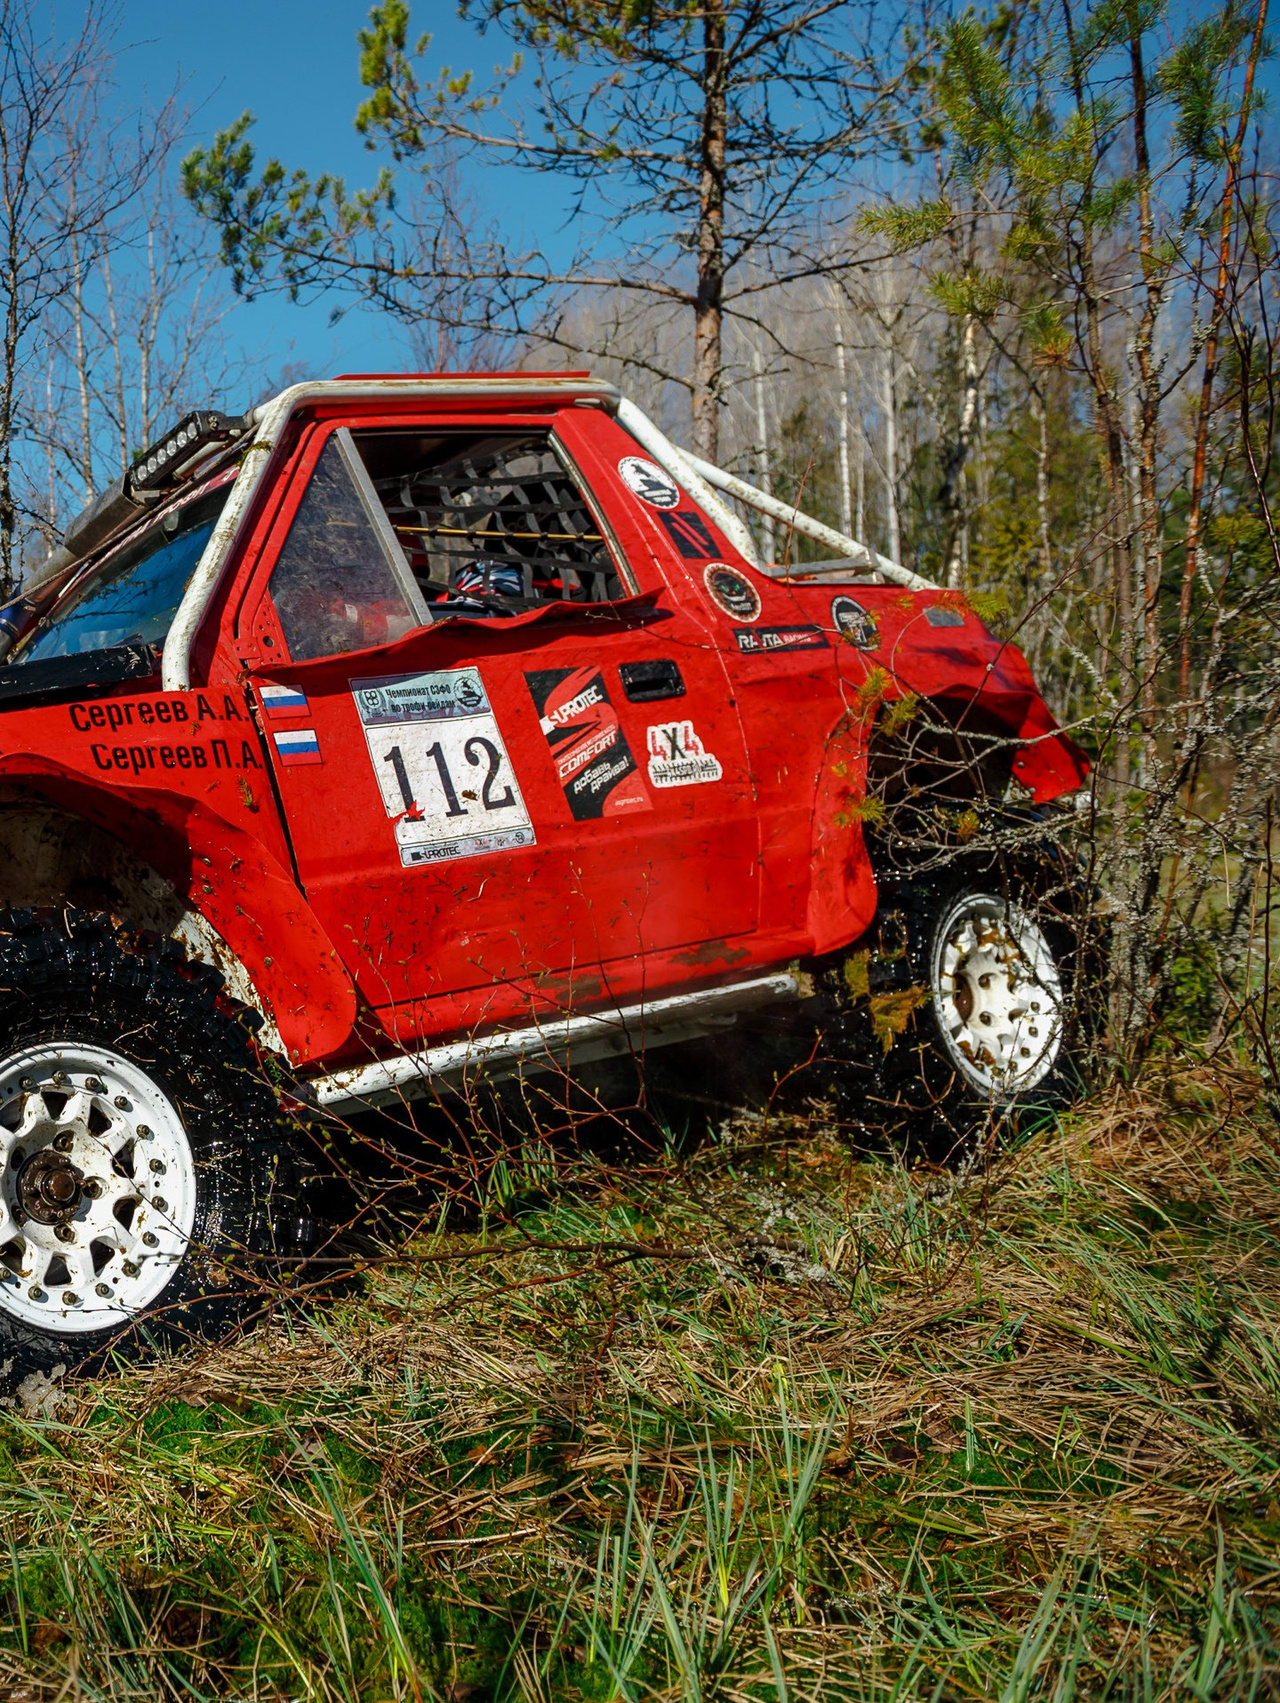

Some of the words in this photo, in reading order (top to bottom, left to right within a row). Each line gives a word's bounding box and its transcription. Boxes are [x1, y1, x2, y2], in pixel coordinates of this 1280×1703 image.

[385, 685, 430, 699] Чемпионат
[430, 684, 452, 696] СЗФО
[391, 703, 402, 713] по
[402, 700, 456, 713] трофи-рейдам
[540, 685, 604, 735] SUPROTEC
[69, 699, 190, 732] Сергеев
[196, 693, 250, 722] А.А.
[90, 743, 208, 776] Сергеев
[210, 738, 263, 769] П.А.
[559, 730, 617, 779] COMFORT
[651, 725, 700, 761] 4X4
[384, 736, 517, 823] 112
[411, 846, 461, 862] SUPROTEC
